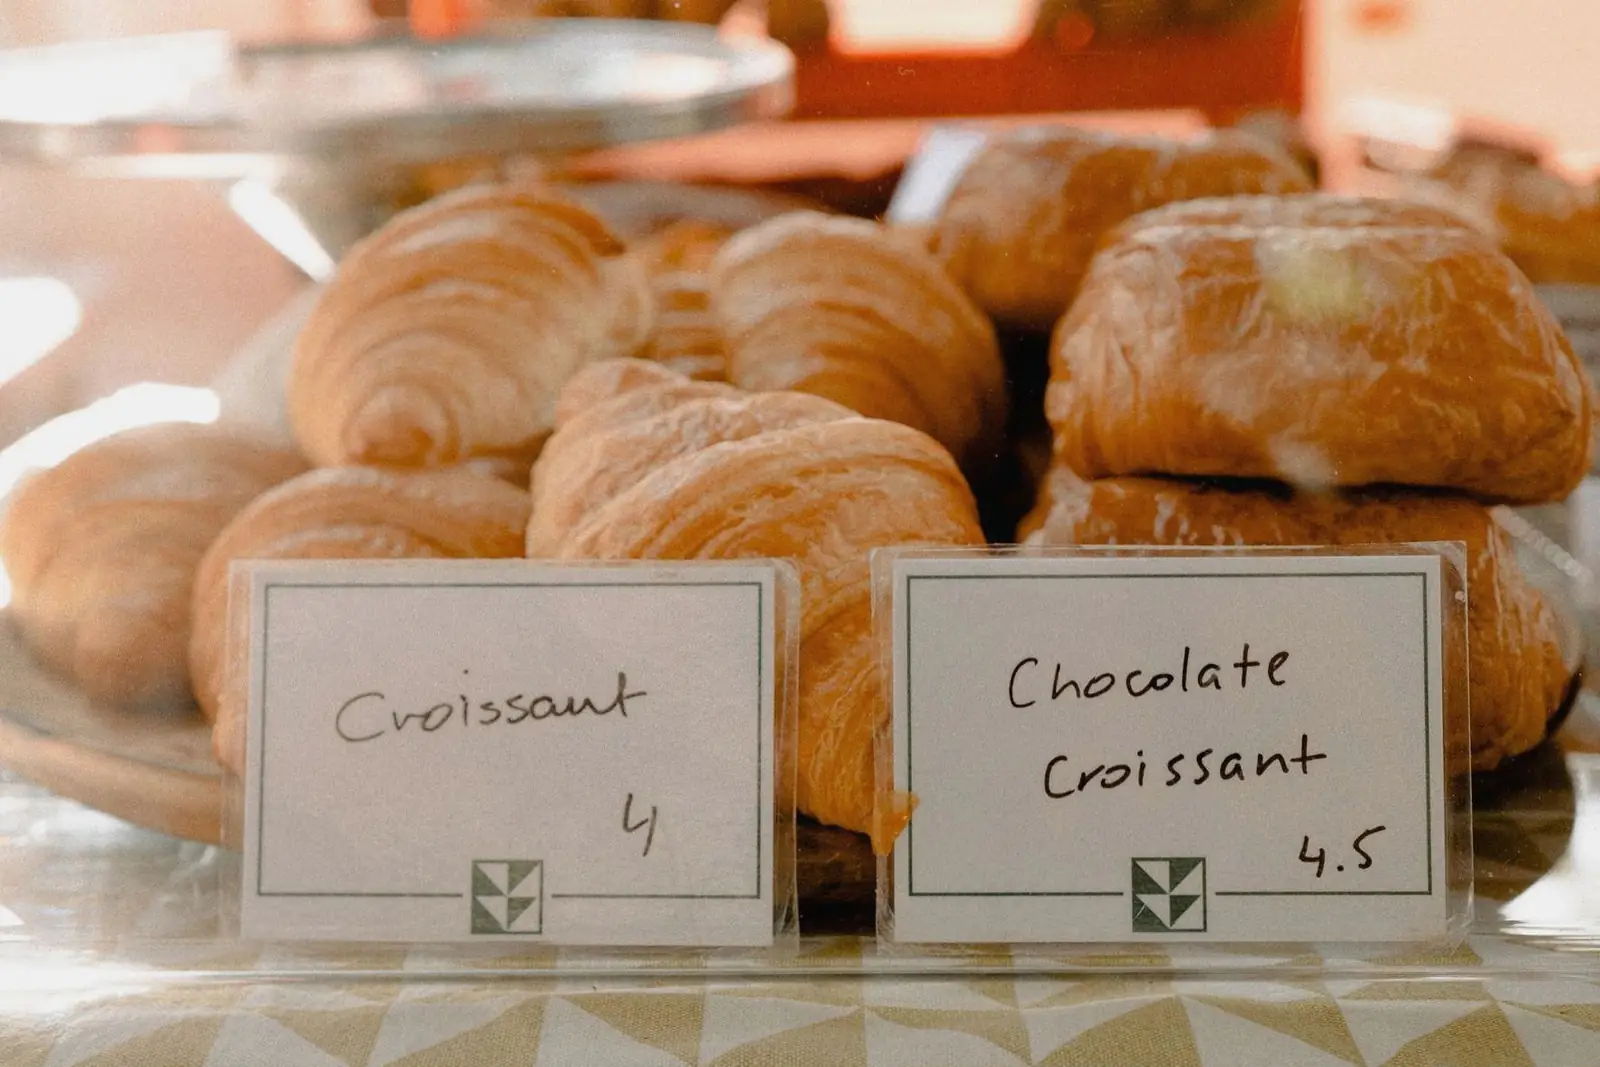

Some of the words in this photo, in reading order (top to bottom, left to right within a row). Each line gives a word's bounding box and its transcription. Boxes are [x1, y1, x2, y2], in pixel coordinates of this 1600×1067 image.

[335, 669, 649, 744] Croissant
[1008, 642, 1291, 709] Chocolate
[1043, 732, 1328, 800] Croissant
[621, 792, 659, 857] 4
[1297, 825, 1388, 879] 4.5
